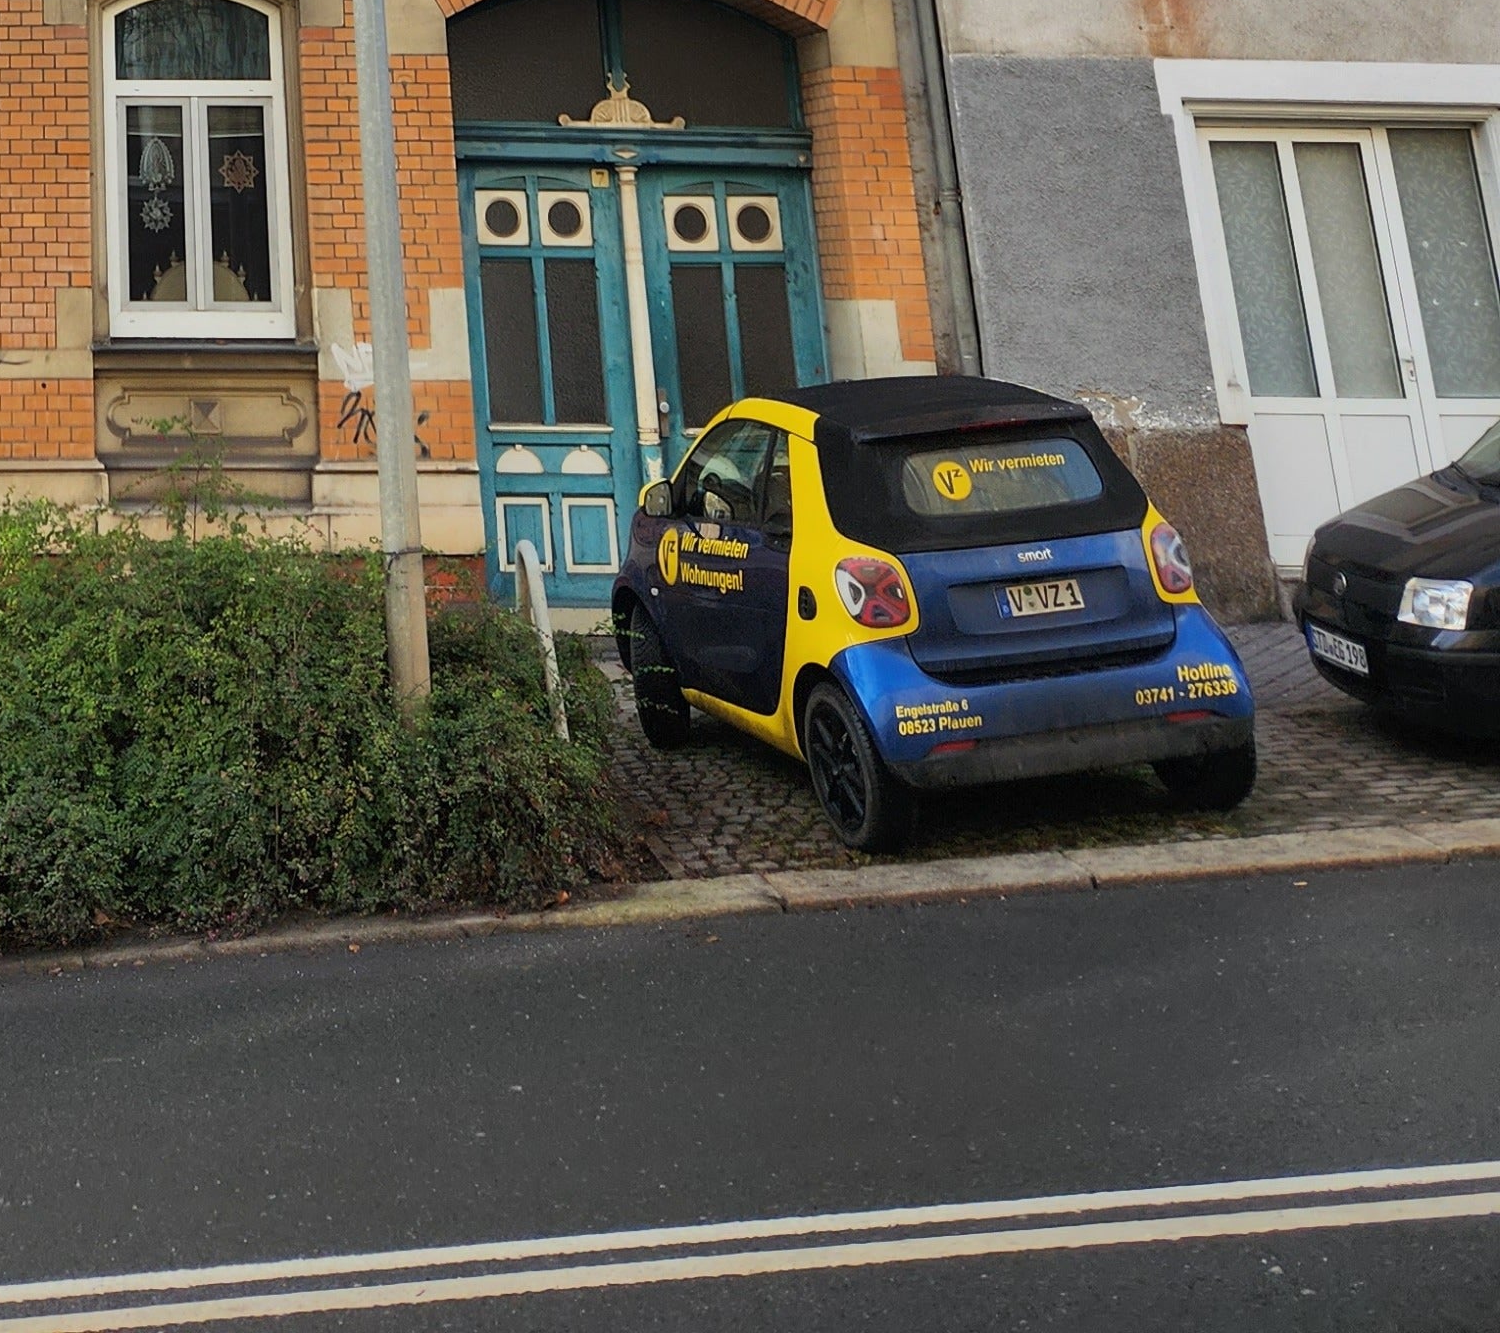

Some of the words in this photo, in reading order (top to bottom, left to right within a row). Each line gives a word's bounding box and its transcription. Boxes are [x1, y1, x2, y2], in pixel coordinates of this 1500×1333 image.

[969, 457, 995, 473] Wir
[997, 453, 1066, 471] vermieten
[681, 531, 698, 553] Wir
[698, 536, 749, 559] vermieten
[1017, 548, 1053, 564] smart
[680, 561, 744, 594] Wohnungen!
[1176, 662, 1233, 682] Hotline
[1135, 686, 1175, 705] 03741
[1187, 679, 1238, 699] 276336
[895, 700, 960, 720] Engelstraße
[961, 698, 969, 711] 6
[898, 718, 937, 736] 08523
[938, 715, 983, 731] Plauen
